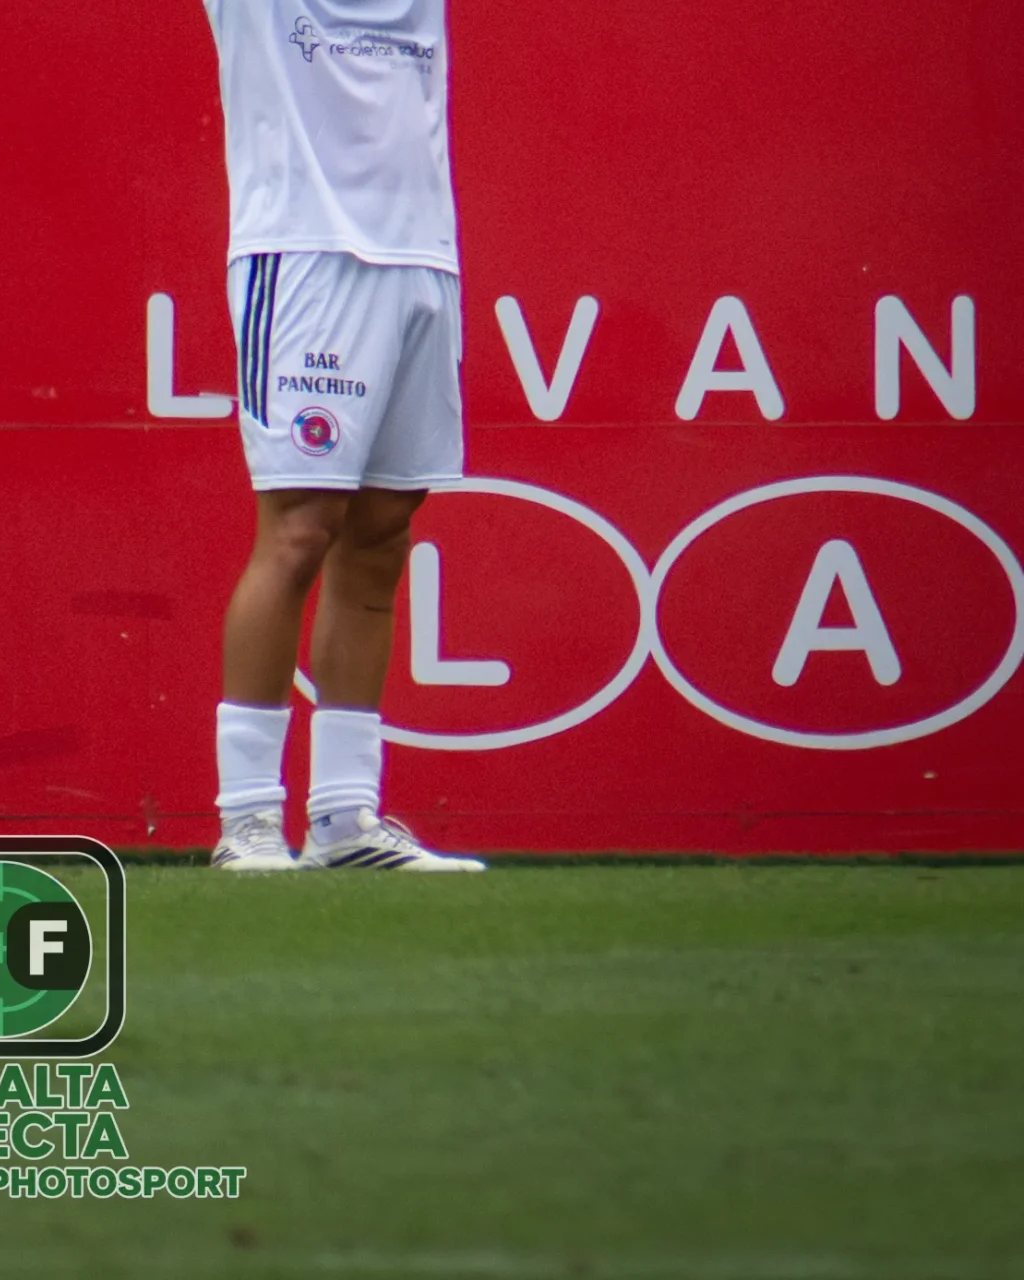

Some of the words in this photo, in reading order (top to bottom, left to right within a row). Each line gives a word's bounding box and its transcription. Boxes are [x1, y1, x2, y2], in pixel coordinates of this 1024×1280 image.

[329, 40, 395, 58] reoletas
[304, 352, 341, 371] BAR
[277, 376, 367, 398] PANCHITO
